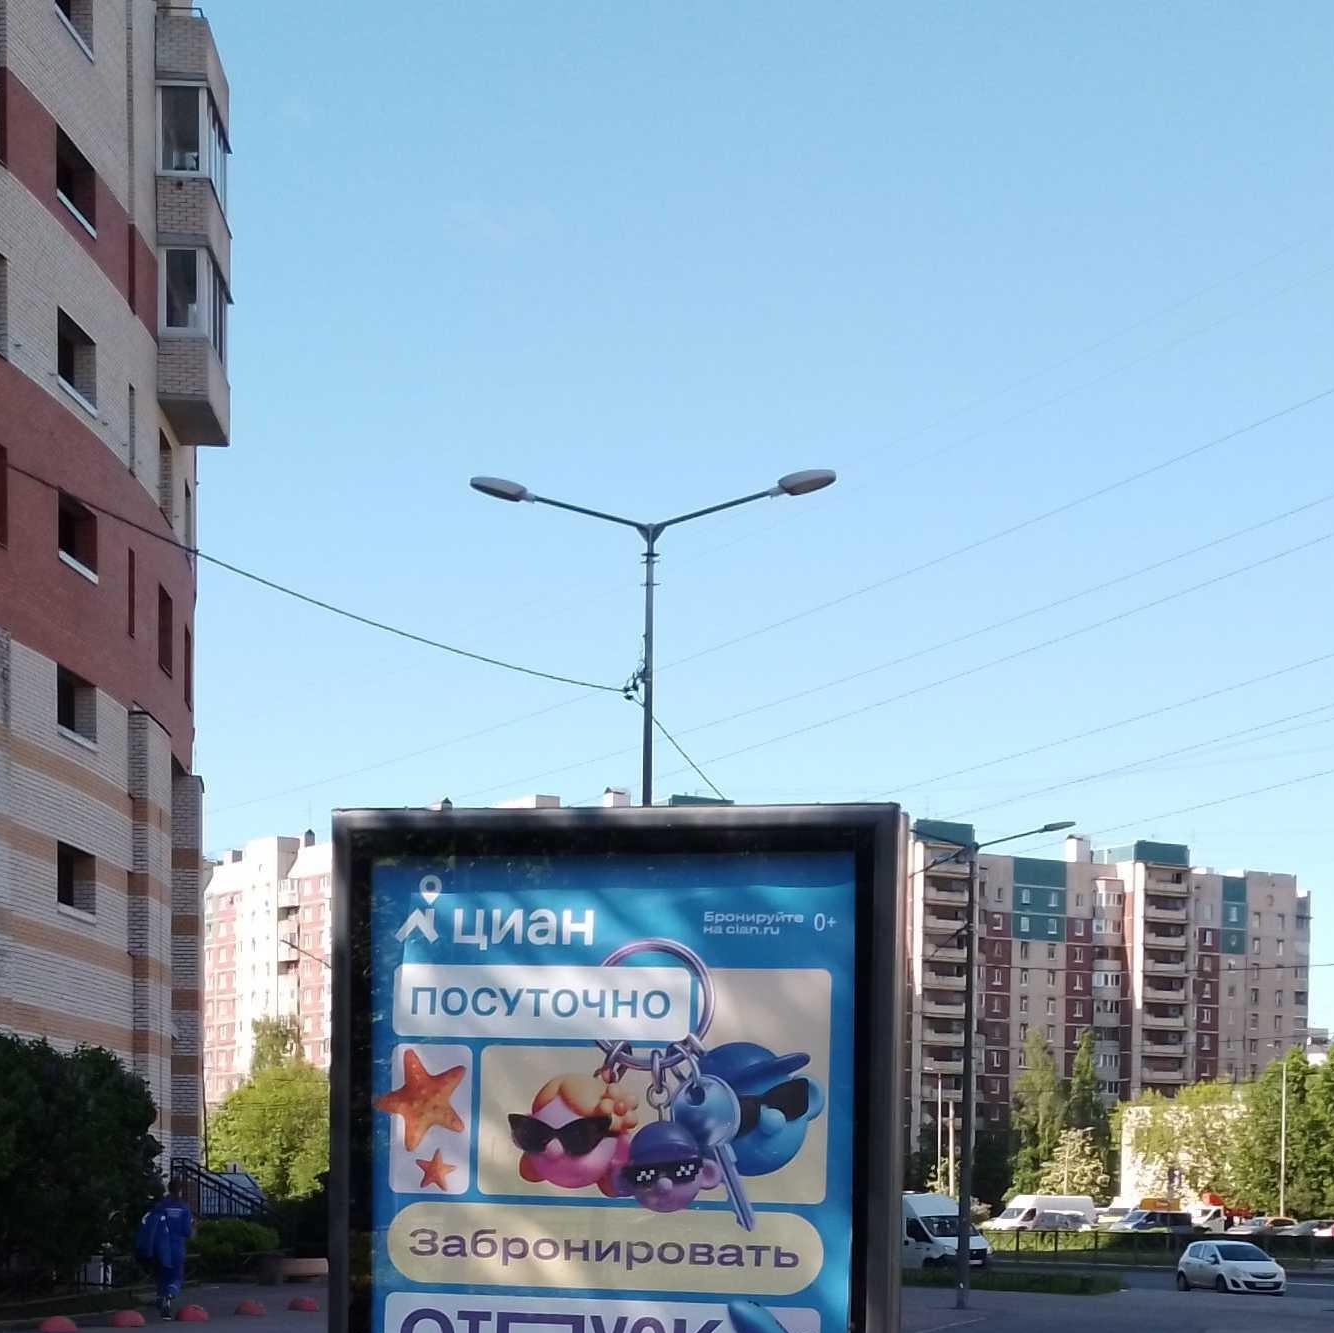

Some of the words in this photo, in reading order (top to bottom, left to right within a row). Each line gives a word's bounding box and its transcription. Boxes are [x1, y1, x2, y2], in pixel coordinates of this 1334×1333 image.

[453, 907, 595, 951] циан
[703, 911, 805, 924] Бронируйте
[703, 925, 723, 934] на
[726, 923, 780, 935] cian.ru
[813, 912, 838, 932] 0+
[410, 986, 672, 1019] ПОСУТОЧНО
[408, 1227, 800, 1271] Забронировать
